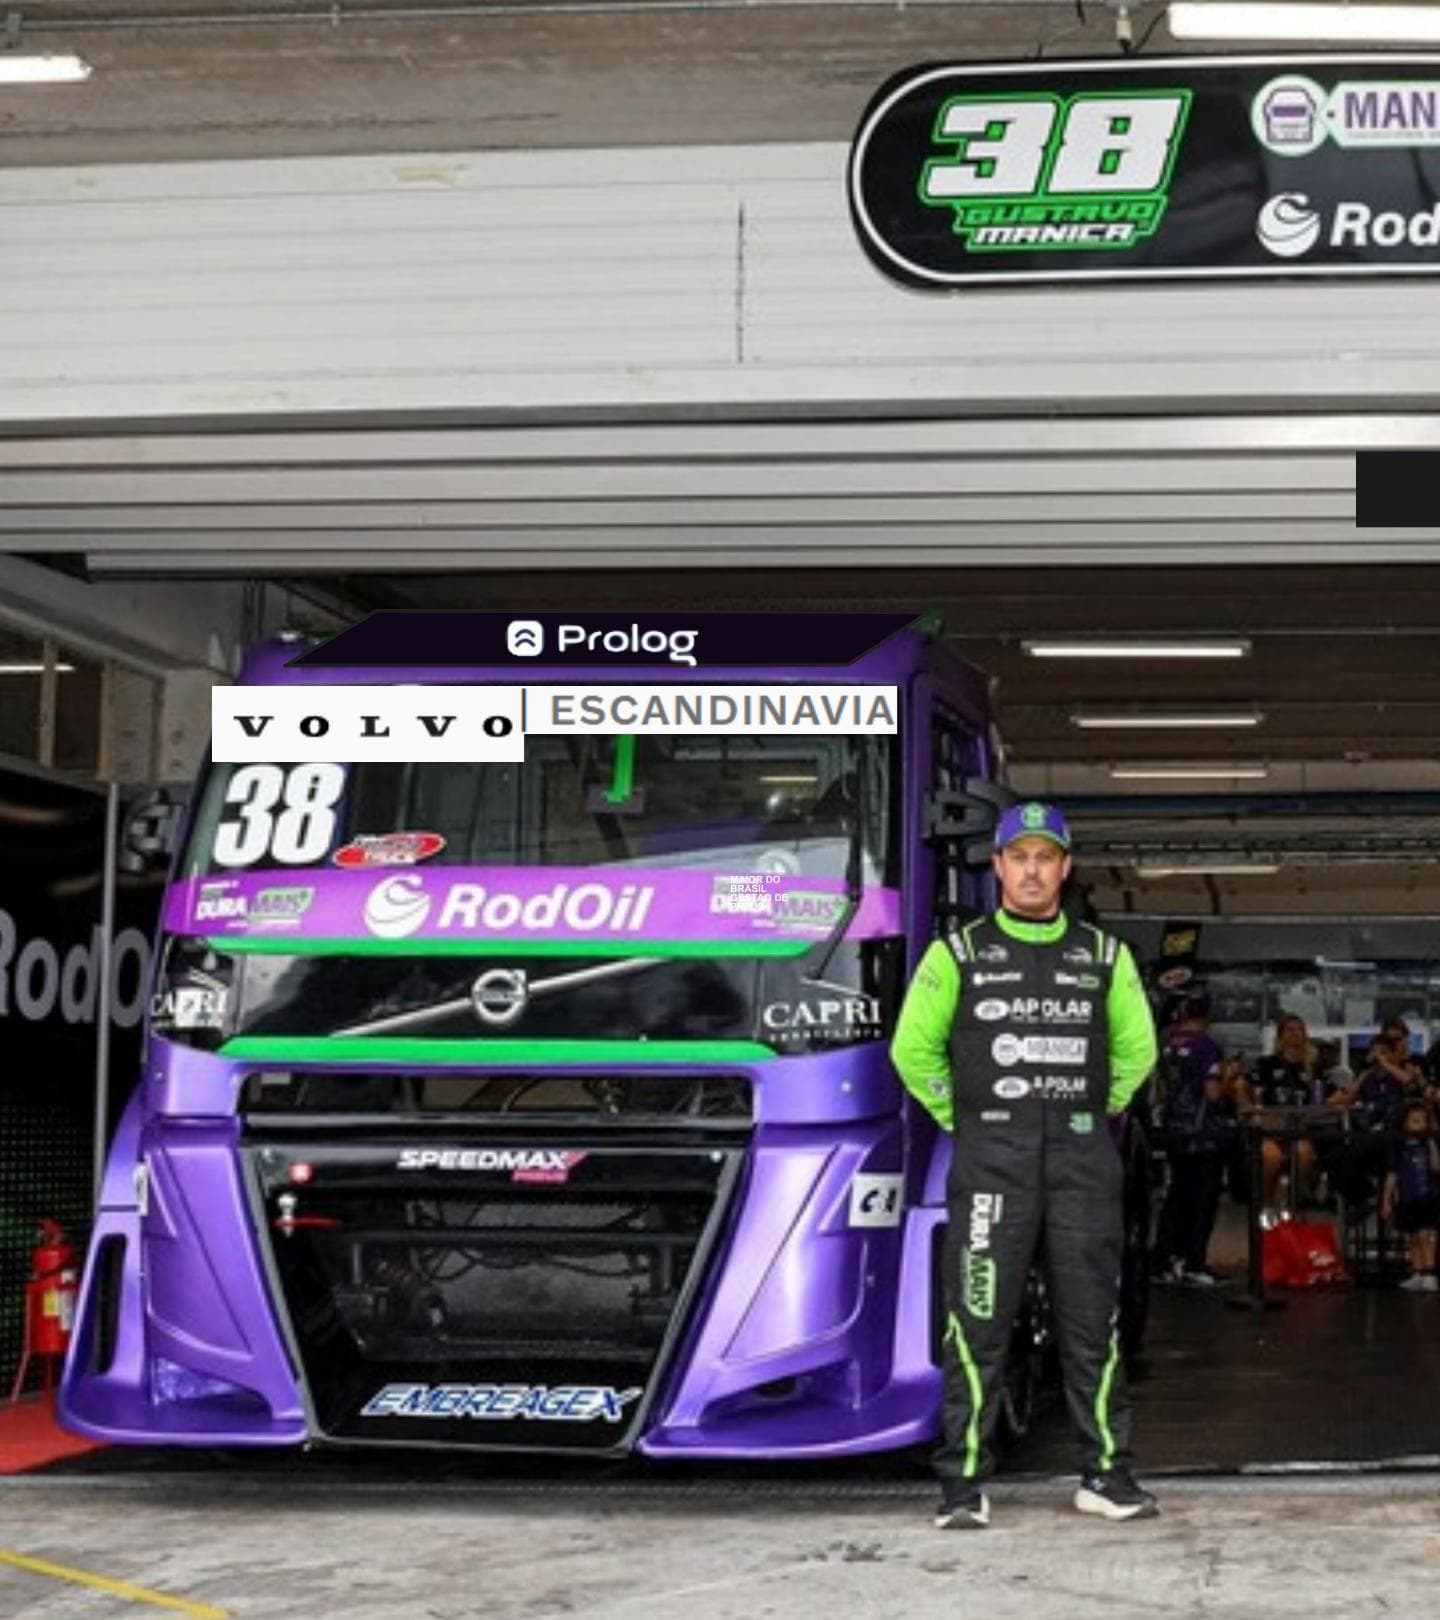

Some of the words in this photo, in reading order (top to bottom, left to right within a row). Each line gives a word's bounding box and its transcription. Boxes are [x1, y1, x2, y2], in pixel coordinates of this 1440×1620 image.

[927, 98, 1182, 197] 38
[963, 202, 1156, 225] GUSTAVO
[974, 223, 1136, 244] MANICA
[213, 762, 346, 867] 38
[438, 882, 655, 931] RodOil
[762, 1000, 882, 1029] CAPRI
[397, 1150, 568, 1171] SPEEDMAX
